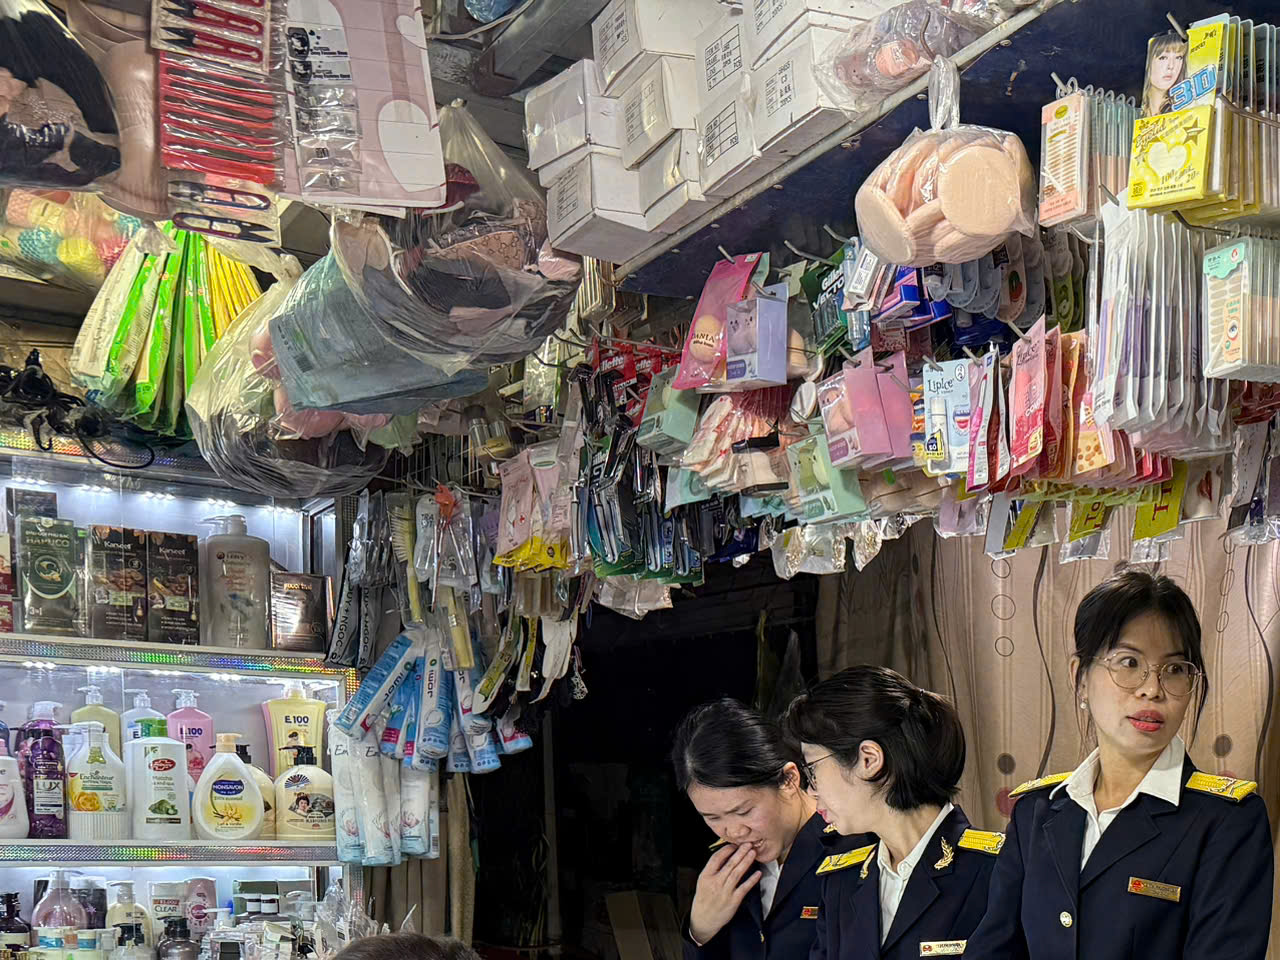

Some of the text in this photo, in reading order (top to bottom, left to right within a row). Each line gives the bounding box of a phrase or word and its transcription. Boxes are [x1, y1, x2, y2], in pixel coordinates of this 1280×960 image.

[1168, 64, 1217, 112] 3D
[928, 378, 953, 394] LipIce
[36, 781, 61, 791] LUX
[154, 904, 177, 912] CLEAR
